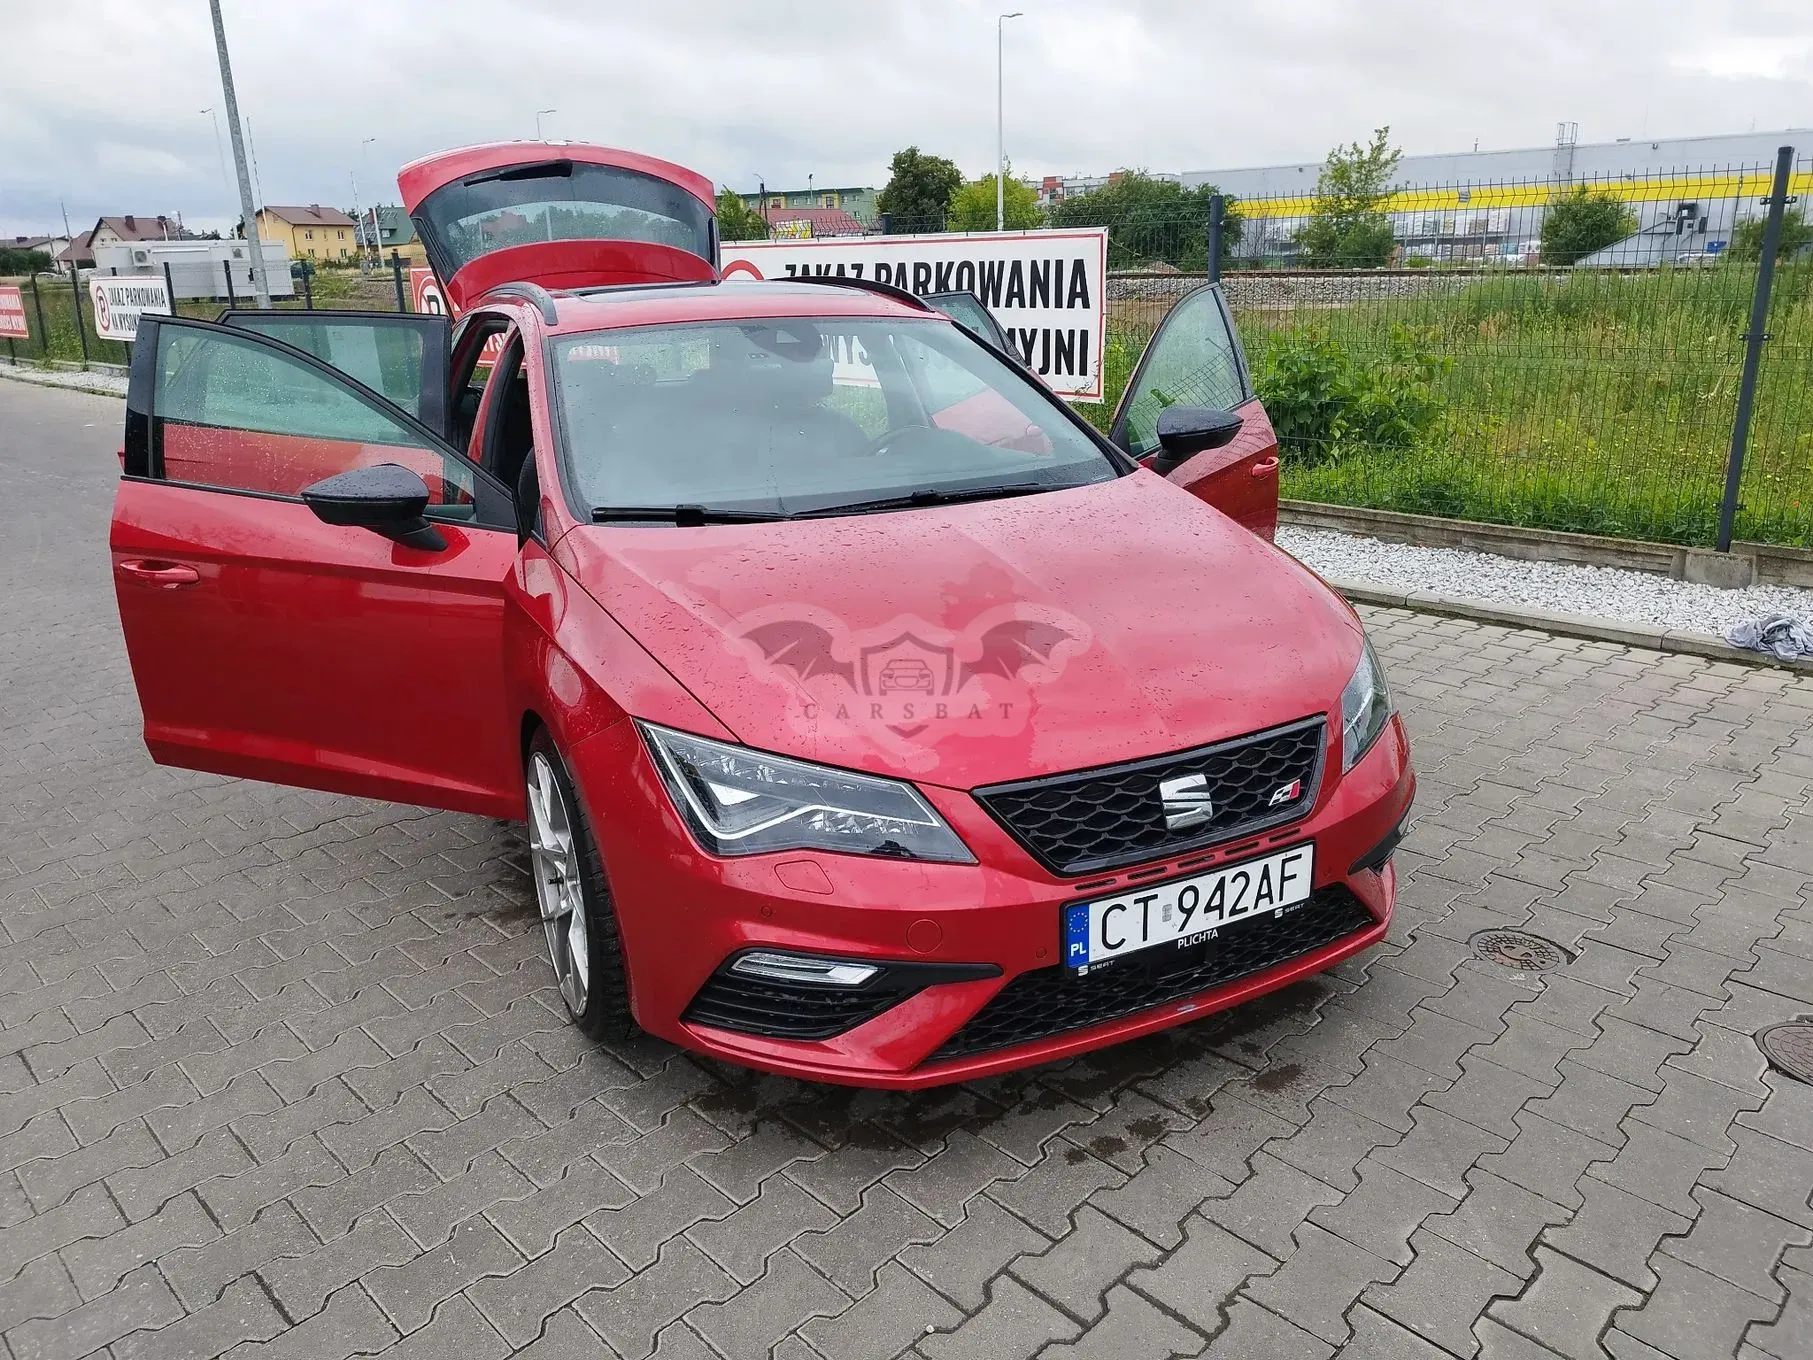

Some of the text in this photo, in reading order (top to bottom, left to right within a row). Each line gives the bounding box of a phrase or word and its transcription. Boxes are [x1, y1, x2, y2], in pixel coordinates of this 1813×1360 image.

[125, 287, 167, 308] PARKOWANIA
[118, 312, 141, 332] WYSOK
[1101, 853, 1303, 951] CT 942AF
[1070, 941, 1087, 957] PL
[1177, 928, 1219, 950] PLICHTA
